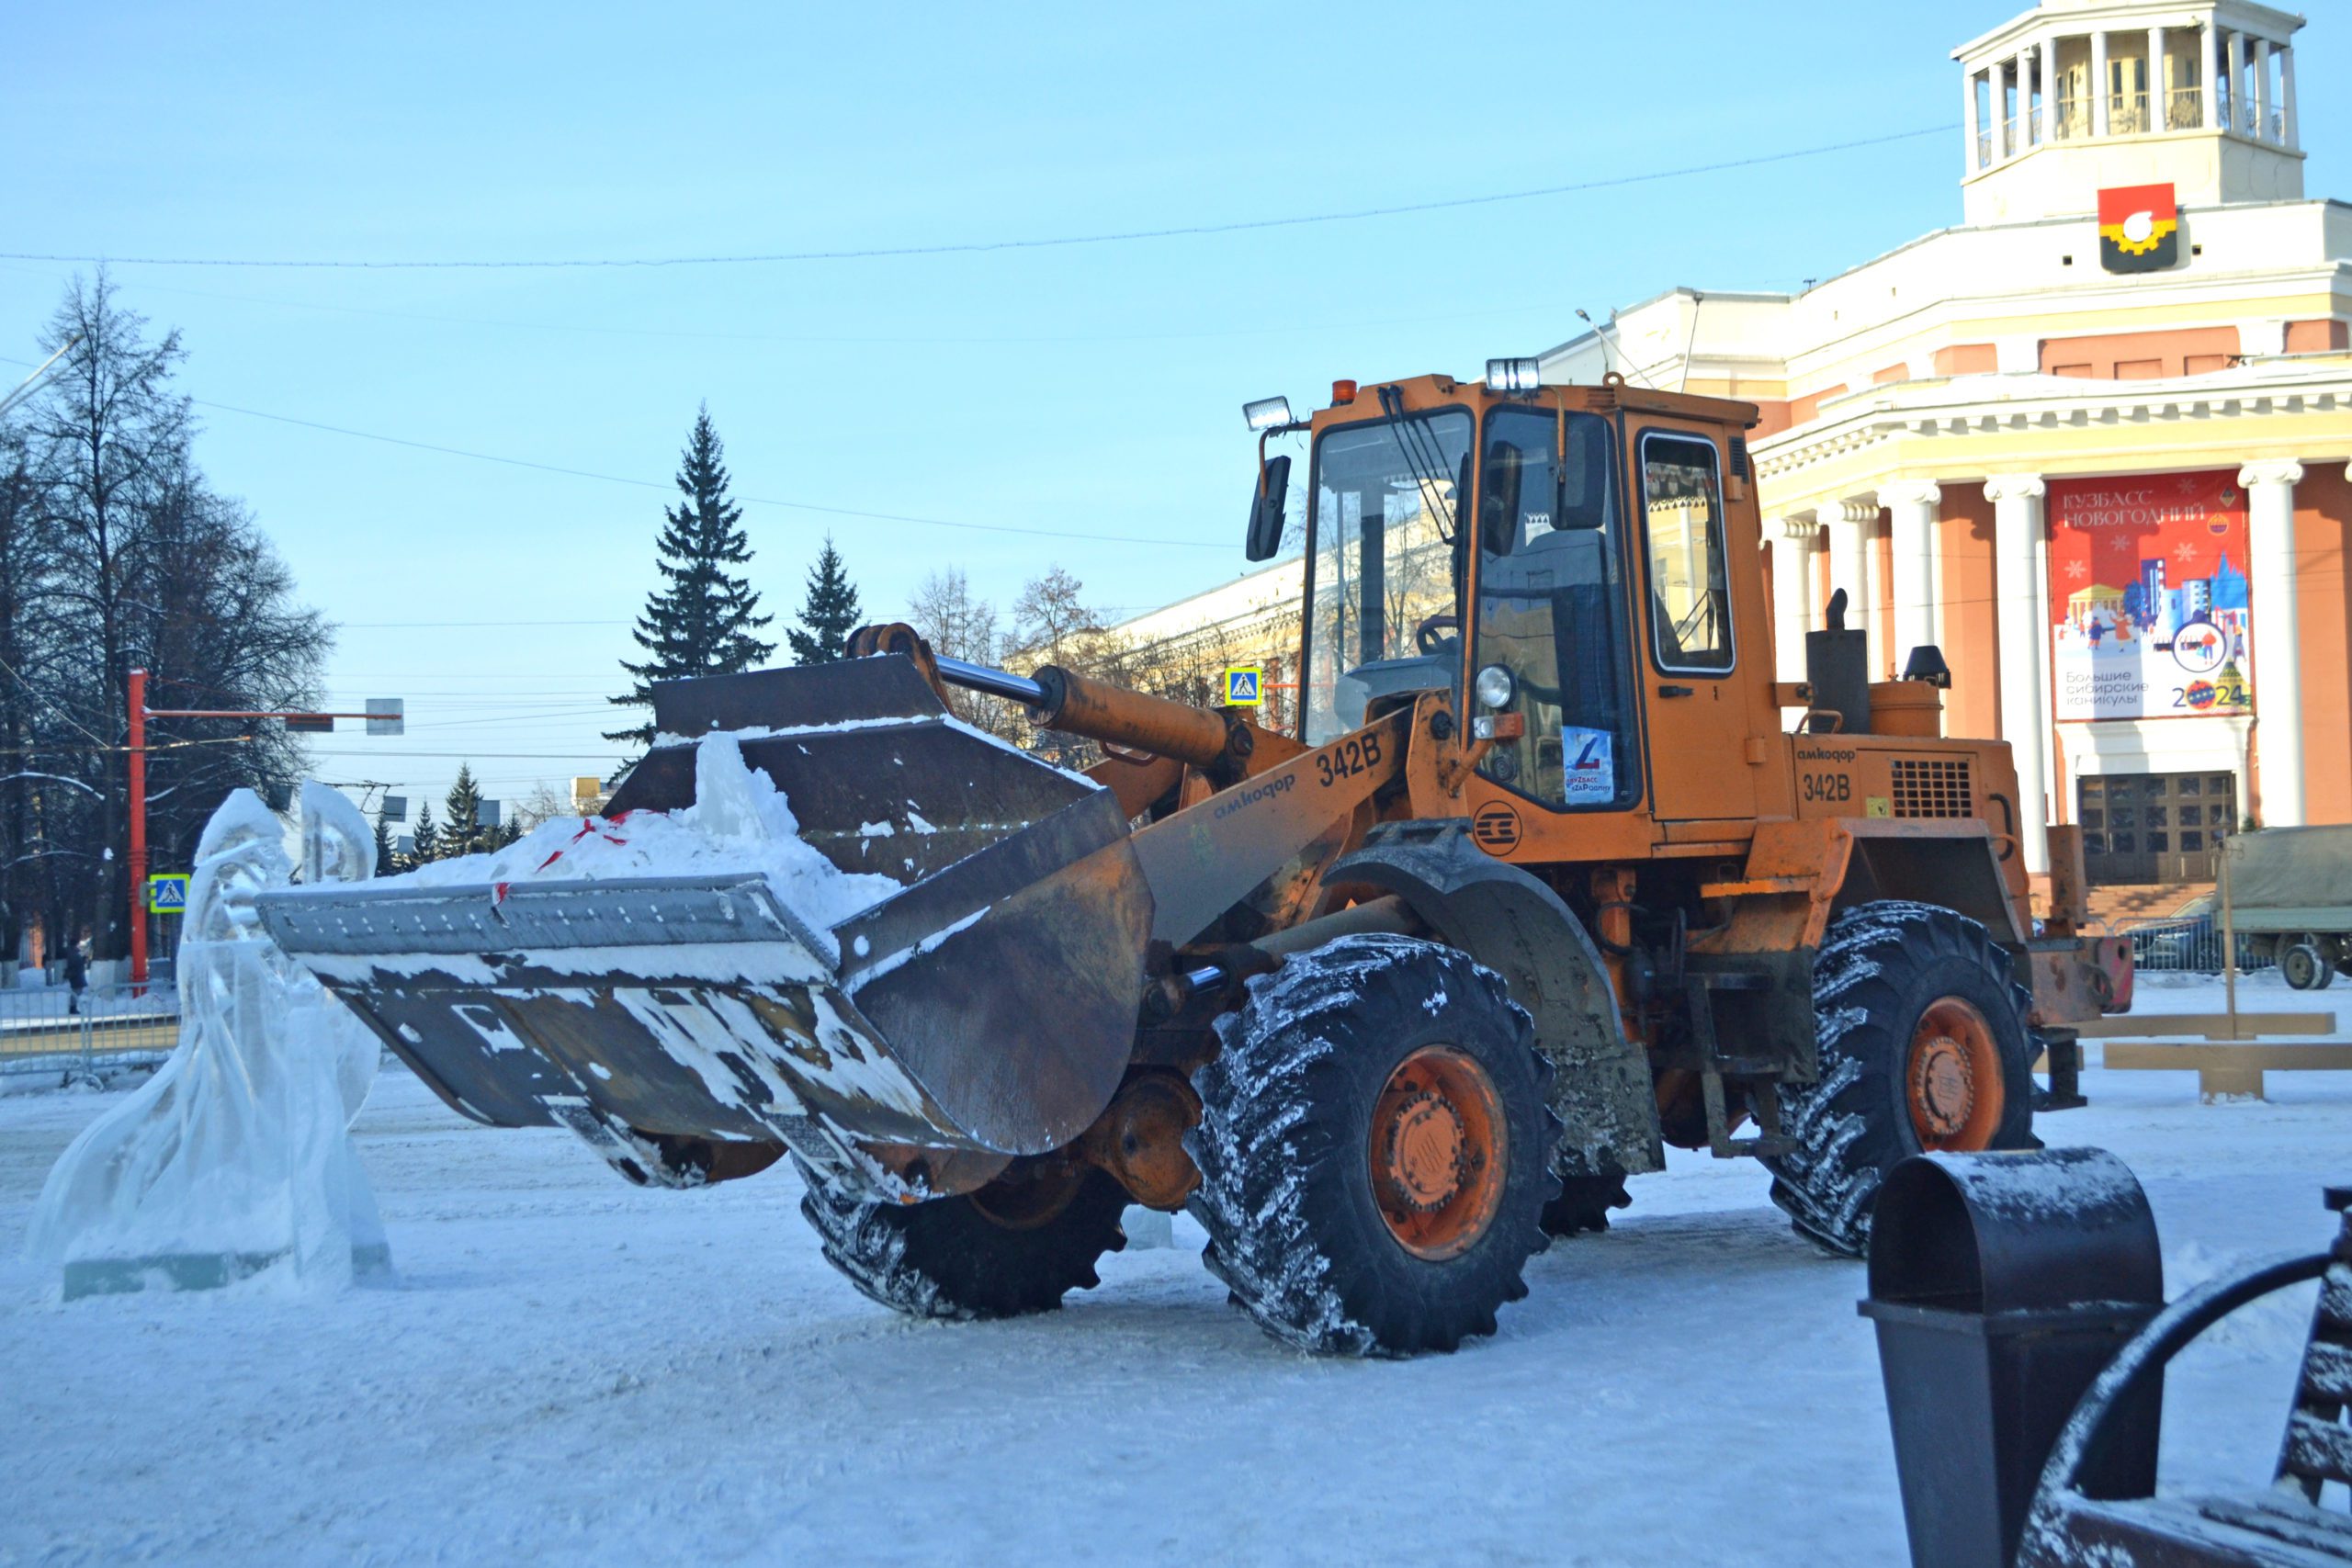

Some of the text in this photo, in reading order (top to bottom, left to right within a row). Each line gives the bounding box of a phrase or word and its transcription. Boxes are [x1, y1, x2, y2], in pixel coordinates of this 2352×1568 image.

[2064, 490, 2153, 509] КУЗБАСС
[2064, 502, 2205, 527] НОВОГОДНИЙ
[2066, 671, 2132, 683] Большие
[2066, 682, 2149, 695] сибирские
[2066, 694, 2137, 706] каникулы
